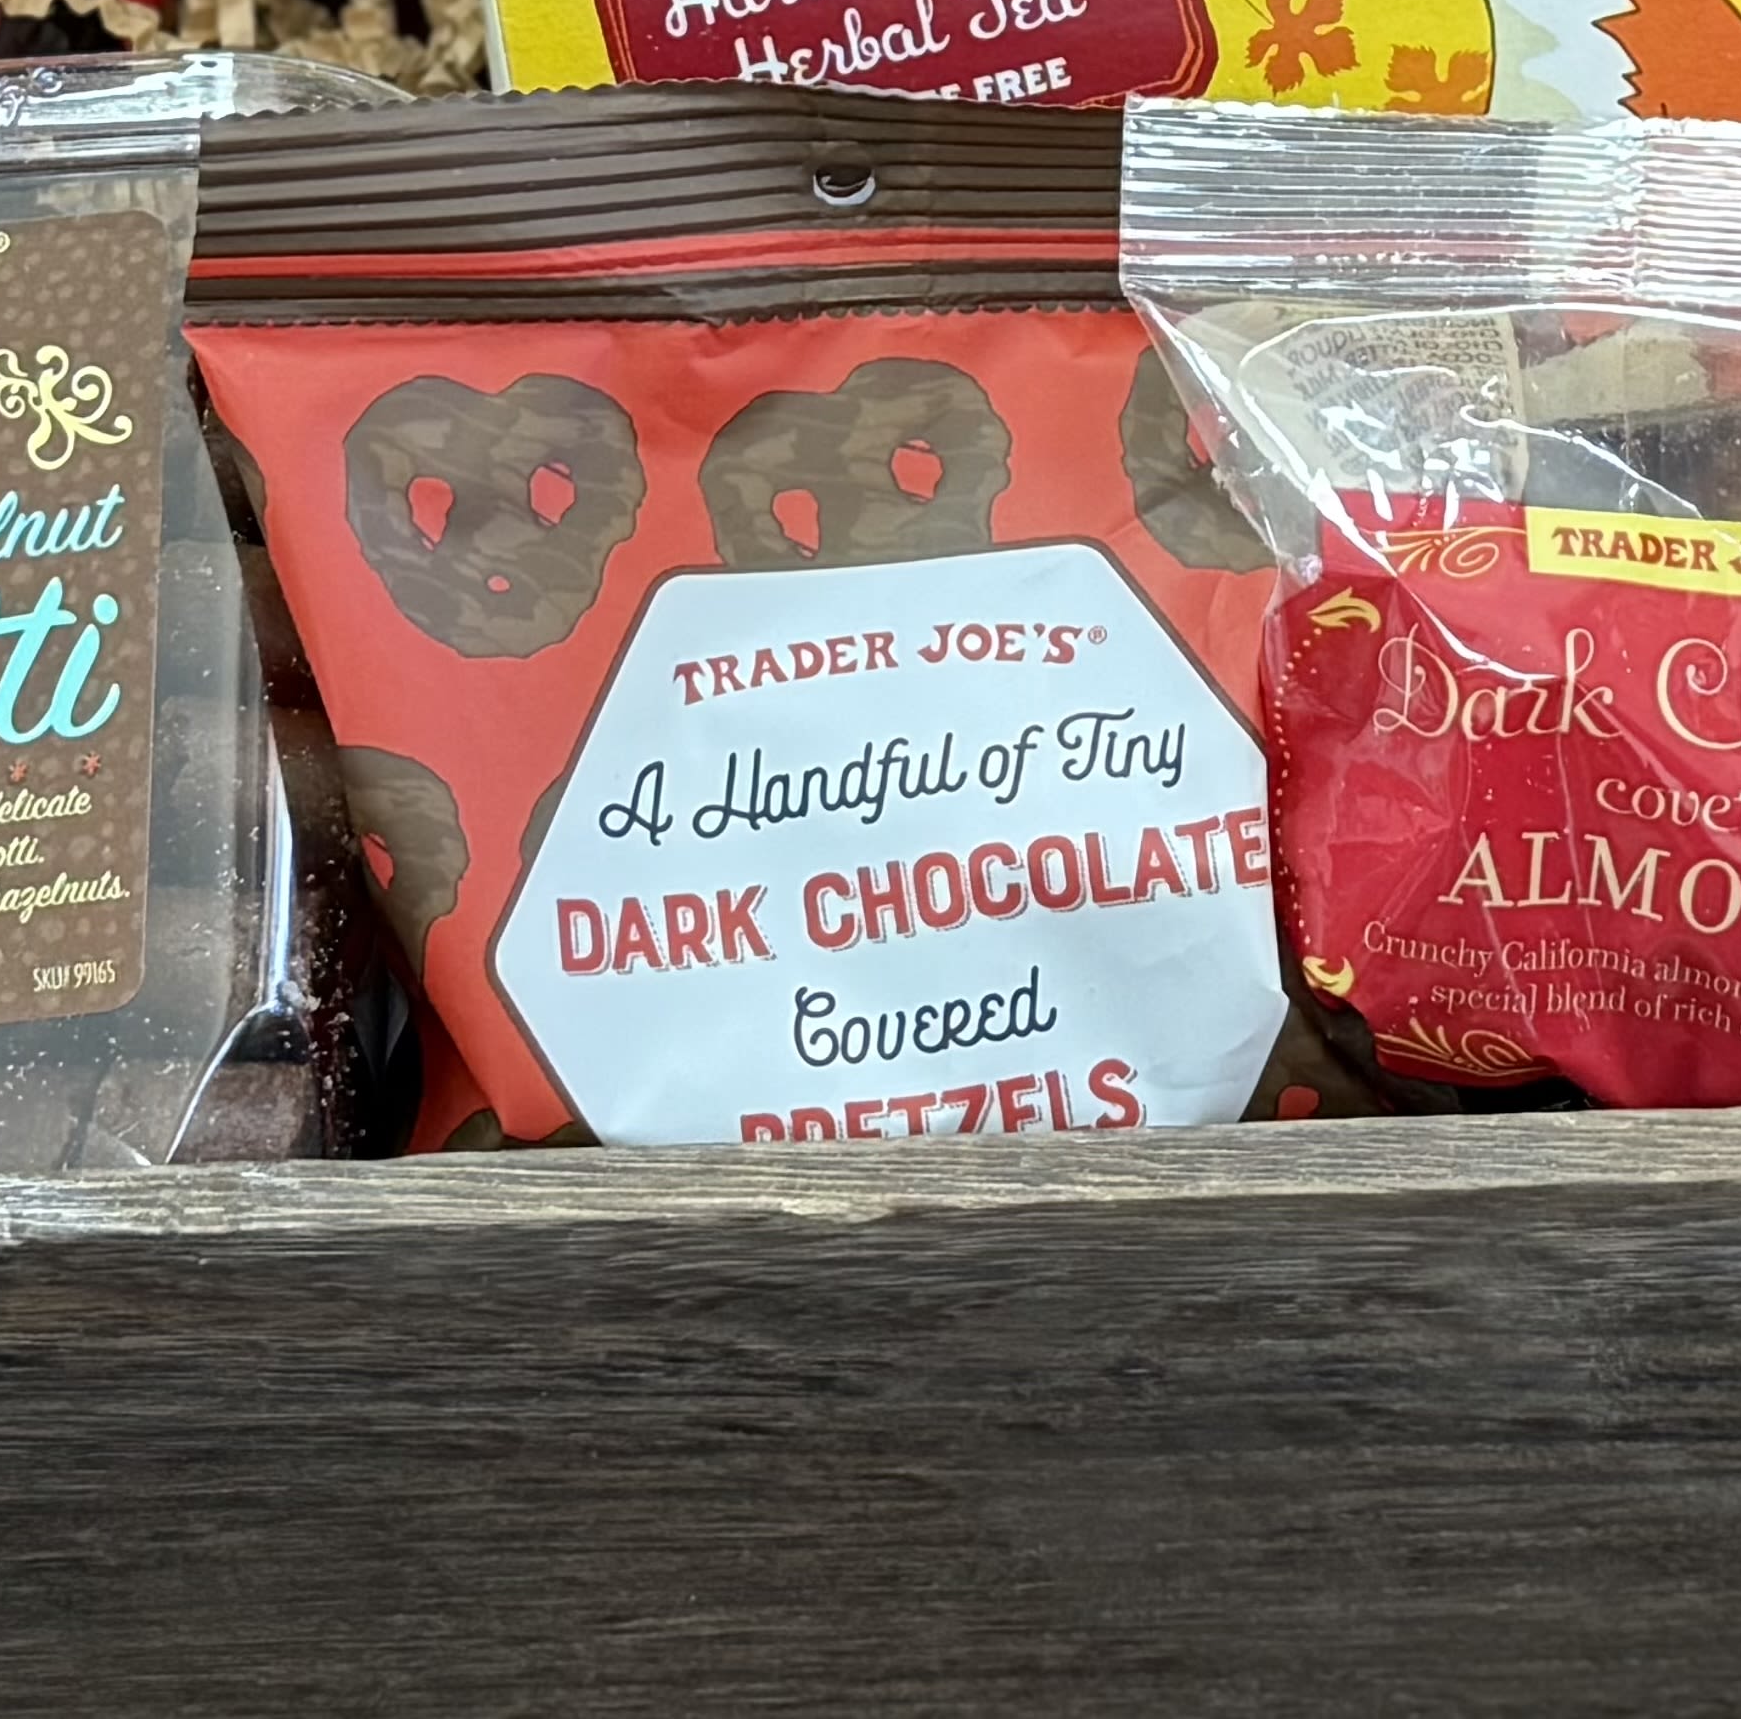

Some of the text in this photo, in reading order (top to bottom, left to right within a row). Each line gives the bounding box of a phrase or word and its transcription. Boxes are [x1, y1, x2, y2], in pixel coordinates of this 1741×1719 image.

[971, 56, 1073, 102] FREE
[1552, 525, 1716, 573] TRADER
[671, 622, 900, 706] TRADER
[1372, 626, 1624, 743] Dark
[598, 706, 1187, 847] A Handful of Tiny
[554, 806, 1272, 978] DARK CHOCOLATE
[1363, 919, 1494, 978] Crunchy
[1501, 937, 1647, 979] California
[791, 964, 1059, 1069] Covered
[1430, 982, 1538, 1021] special
[1545, 982, 1626, 1014] blend
[1634, 993, 1668, 1021] of
[1673, 995, 1732, 1034] rich
